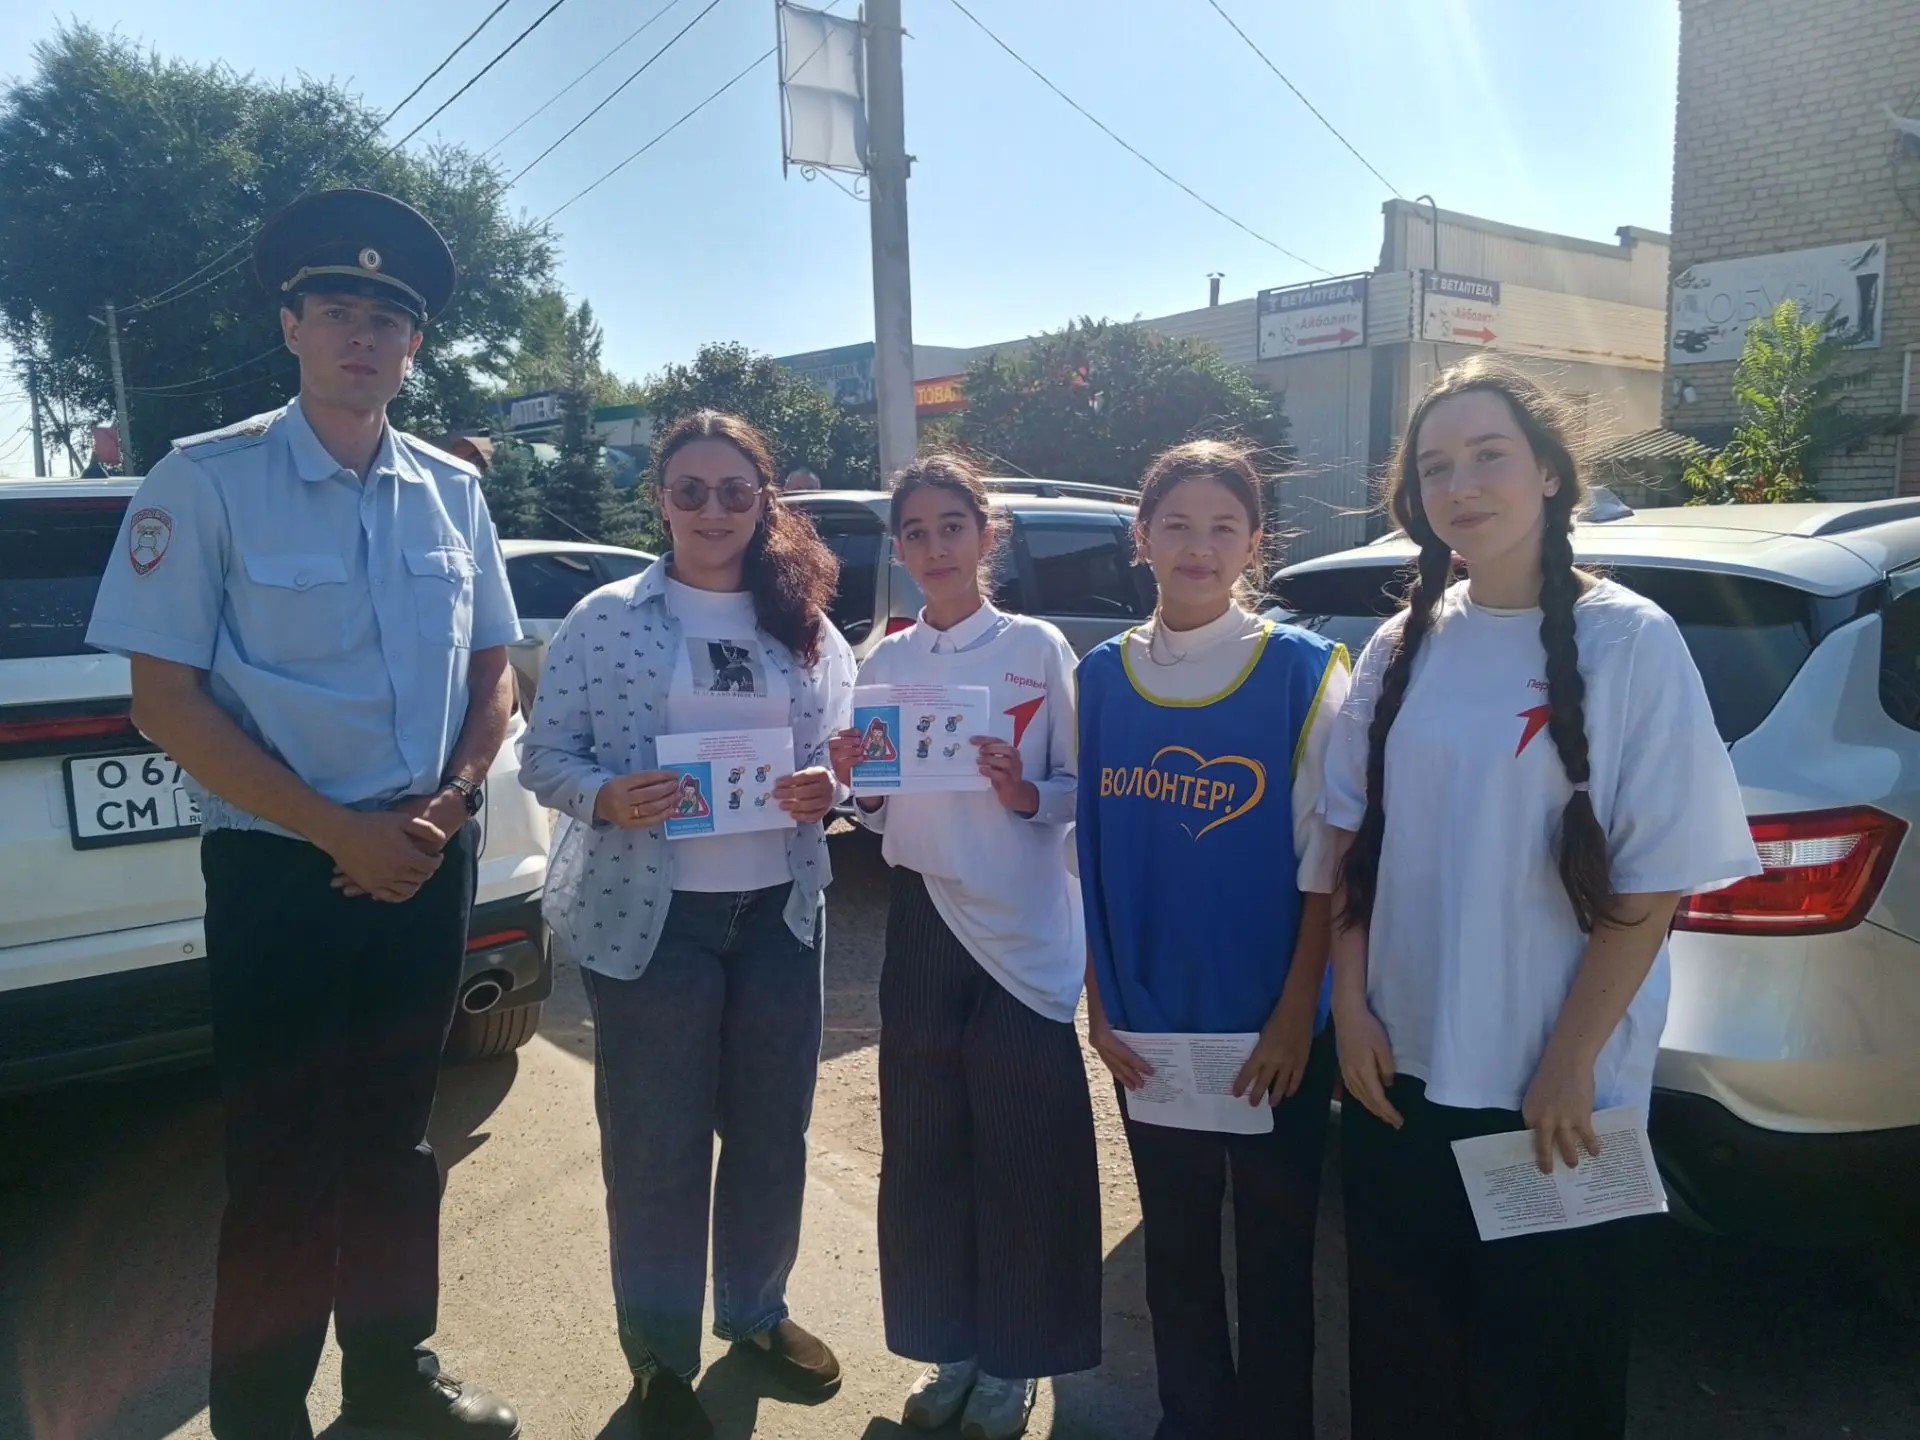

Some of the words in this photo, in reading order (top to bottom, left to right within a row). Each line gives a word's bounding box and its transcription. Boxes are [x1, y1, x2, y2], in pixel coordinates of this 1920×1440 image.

[1280, 285, 1355, 308] ВЕТАПТЕКА
[1441, 278, 1494, 298] ВЕТАПТЕКА
[917, 384, 956, 405] ТОВА
[1526, 678, 1549, 692] Пер
[142, 757, 182, 786] 67
[1100, 767, 1235, 813] ВОЛОНТЕР!
[97, 797, 159, 830] СМ
